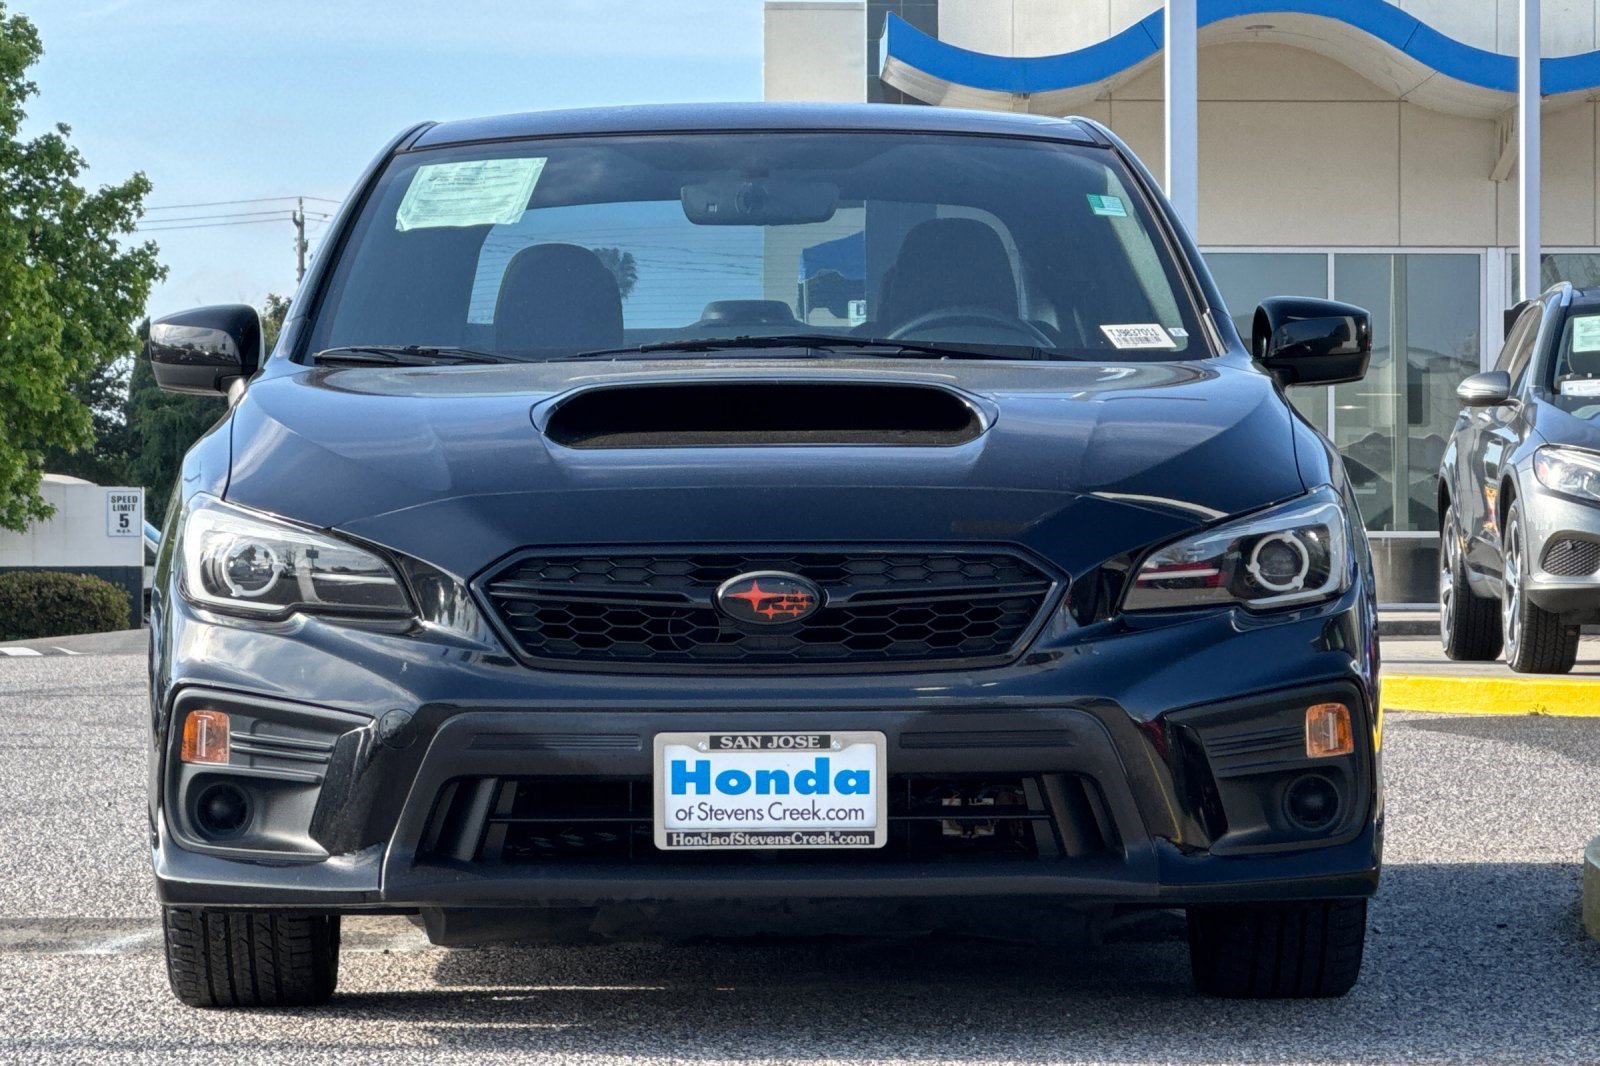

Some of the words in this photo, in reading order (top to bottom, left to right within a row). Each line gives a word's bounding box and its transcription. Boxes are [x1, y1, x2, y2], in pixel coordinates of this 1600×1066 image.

[111, 495, 138, 503] SPEED
[119, 513, 129, 528] 5
[720, 736, 761, 749] SAN
[767, 736, 820, 749] JOSE
[671, 757, 870, 795] Honda
[675, 805, 695, 821] of
[697, 801, 764, 821] Stevens
[768, 799, 864, 821] Creek.com
